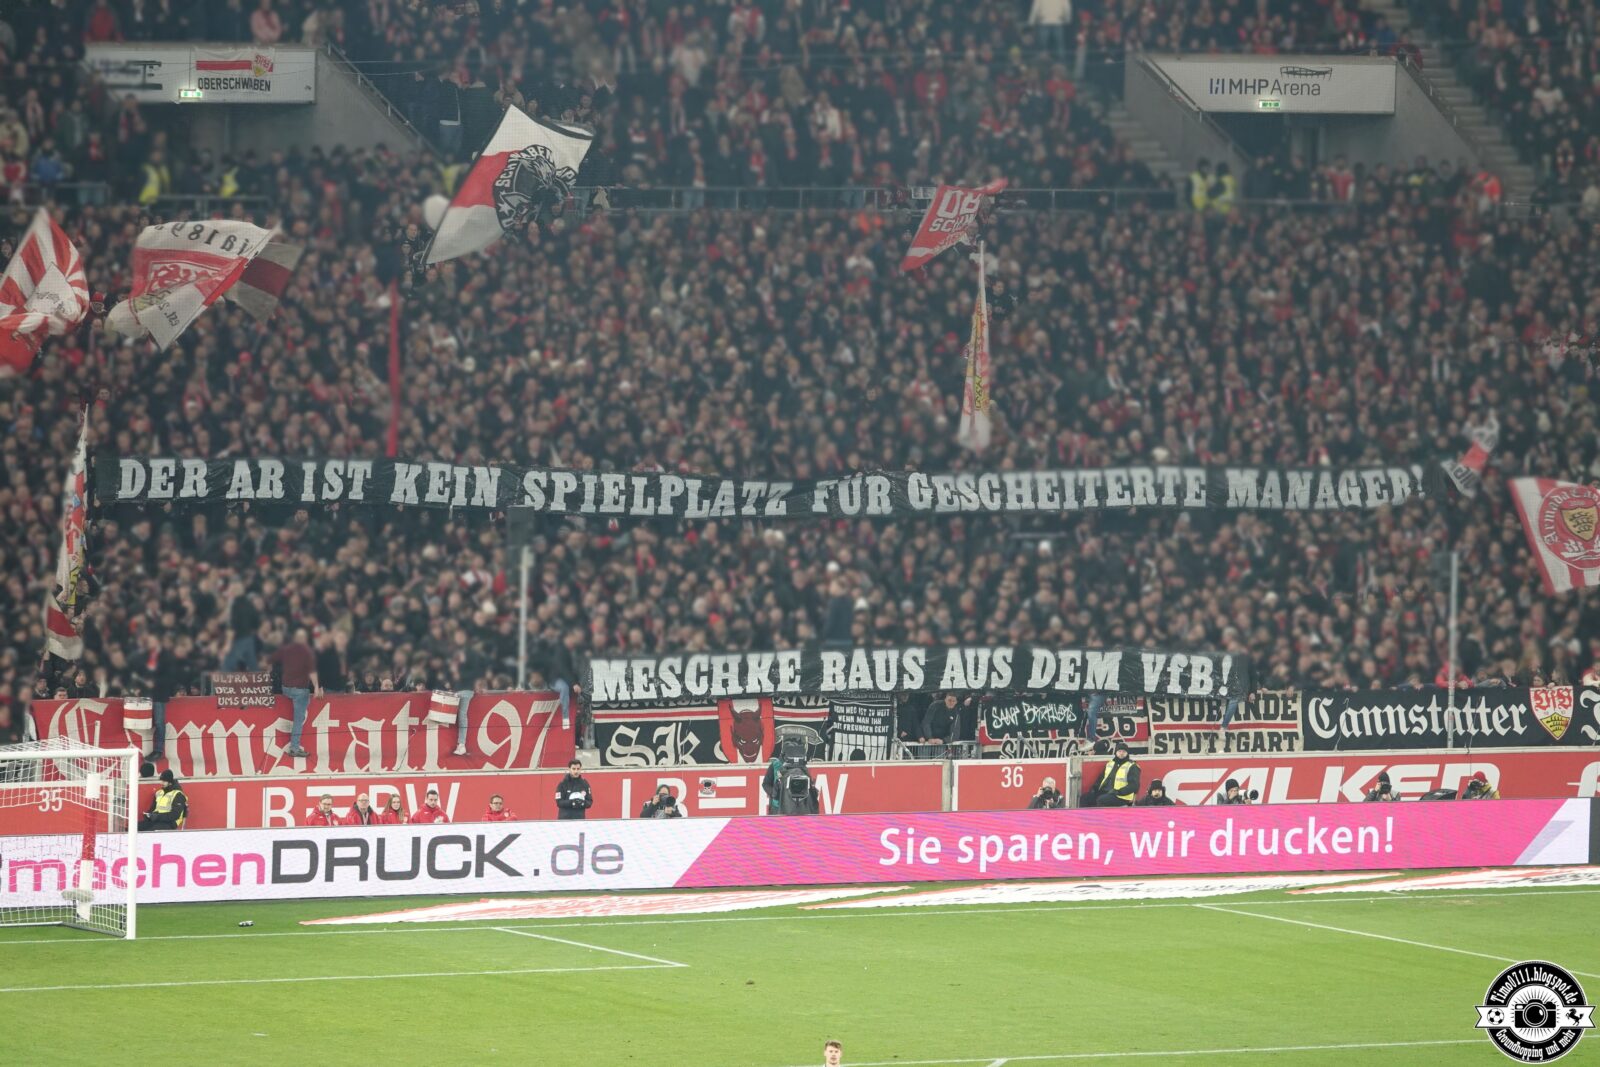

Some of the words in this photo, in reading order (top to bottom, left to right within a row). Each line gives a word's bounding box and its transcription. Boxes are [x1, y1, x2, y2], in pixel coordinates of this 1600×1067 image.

[197, 77, 272, 92] OBERSCHWABEN
[1229, 78, 1269, 95] MHP
[1270, 79, 1321, 96] Arena
[118, 458, 209, 499] DER
[226, 458, 285, 499] AR
[301, 460, 373, 502] IST
[390, 462, 501, 507] KEIN
[522, 469, 794, 519] SPIELPLATZ
[907, 466, 1207, 513] GESCHEITERTE
[1225, 464, 1426, 509] MANAGER!
[591, 649, 801, 701] MESCHKE
[820, 648, 926, 692] RAUS
[940, 647, 1014, 690] AUS
[1027, 647, 1123, 691] DEM
[1140, 652, 1233, 697] VfB!
[215, 686, 236, 695] DER
[217, 696, 240, 706] UMS
[241, 696, 276, 707] GANZE
[1308, 694, 1529, 739] Cannstatter
[477, 699, 561, 771] 97
[1154, 731, 1300, 755] STUTTGART
[1000, 765, 1024, 789] 36
[38, 788, 63, 813] 35
[878, 827, 942, 866] Sie
[957, 831, 1114, 873] sparen,
[1129, 820, 1195, 858] wir
[1209, 816, 1394, 857] drucken!
[0, 832, 625, 893] machenDRUCK.de
